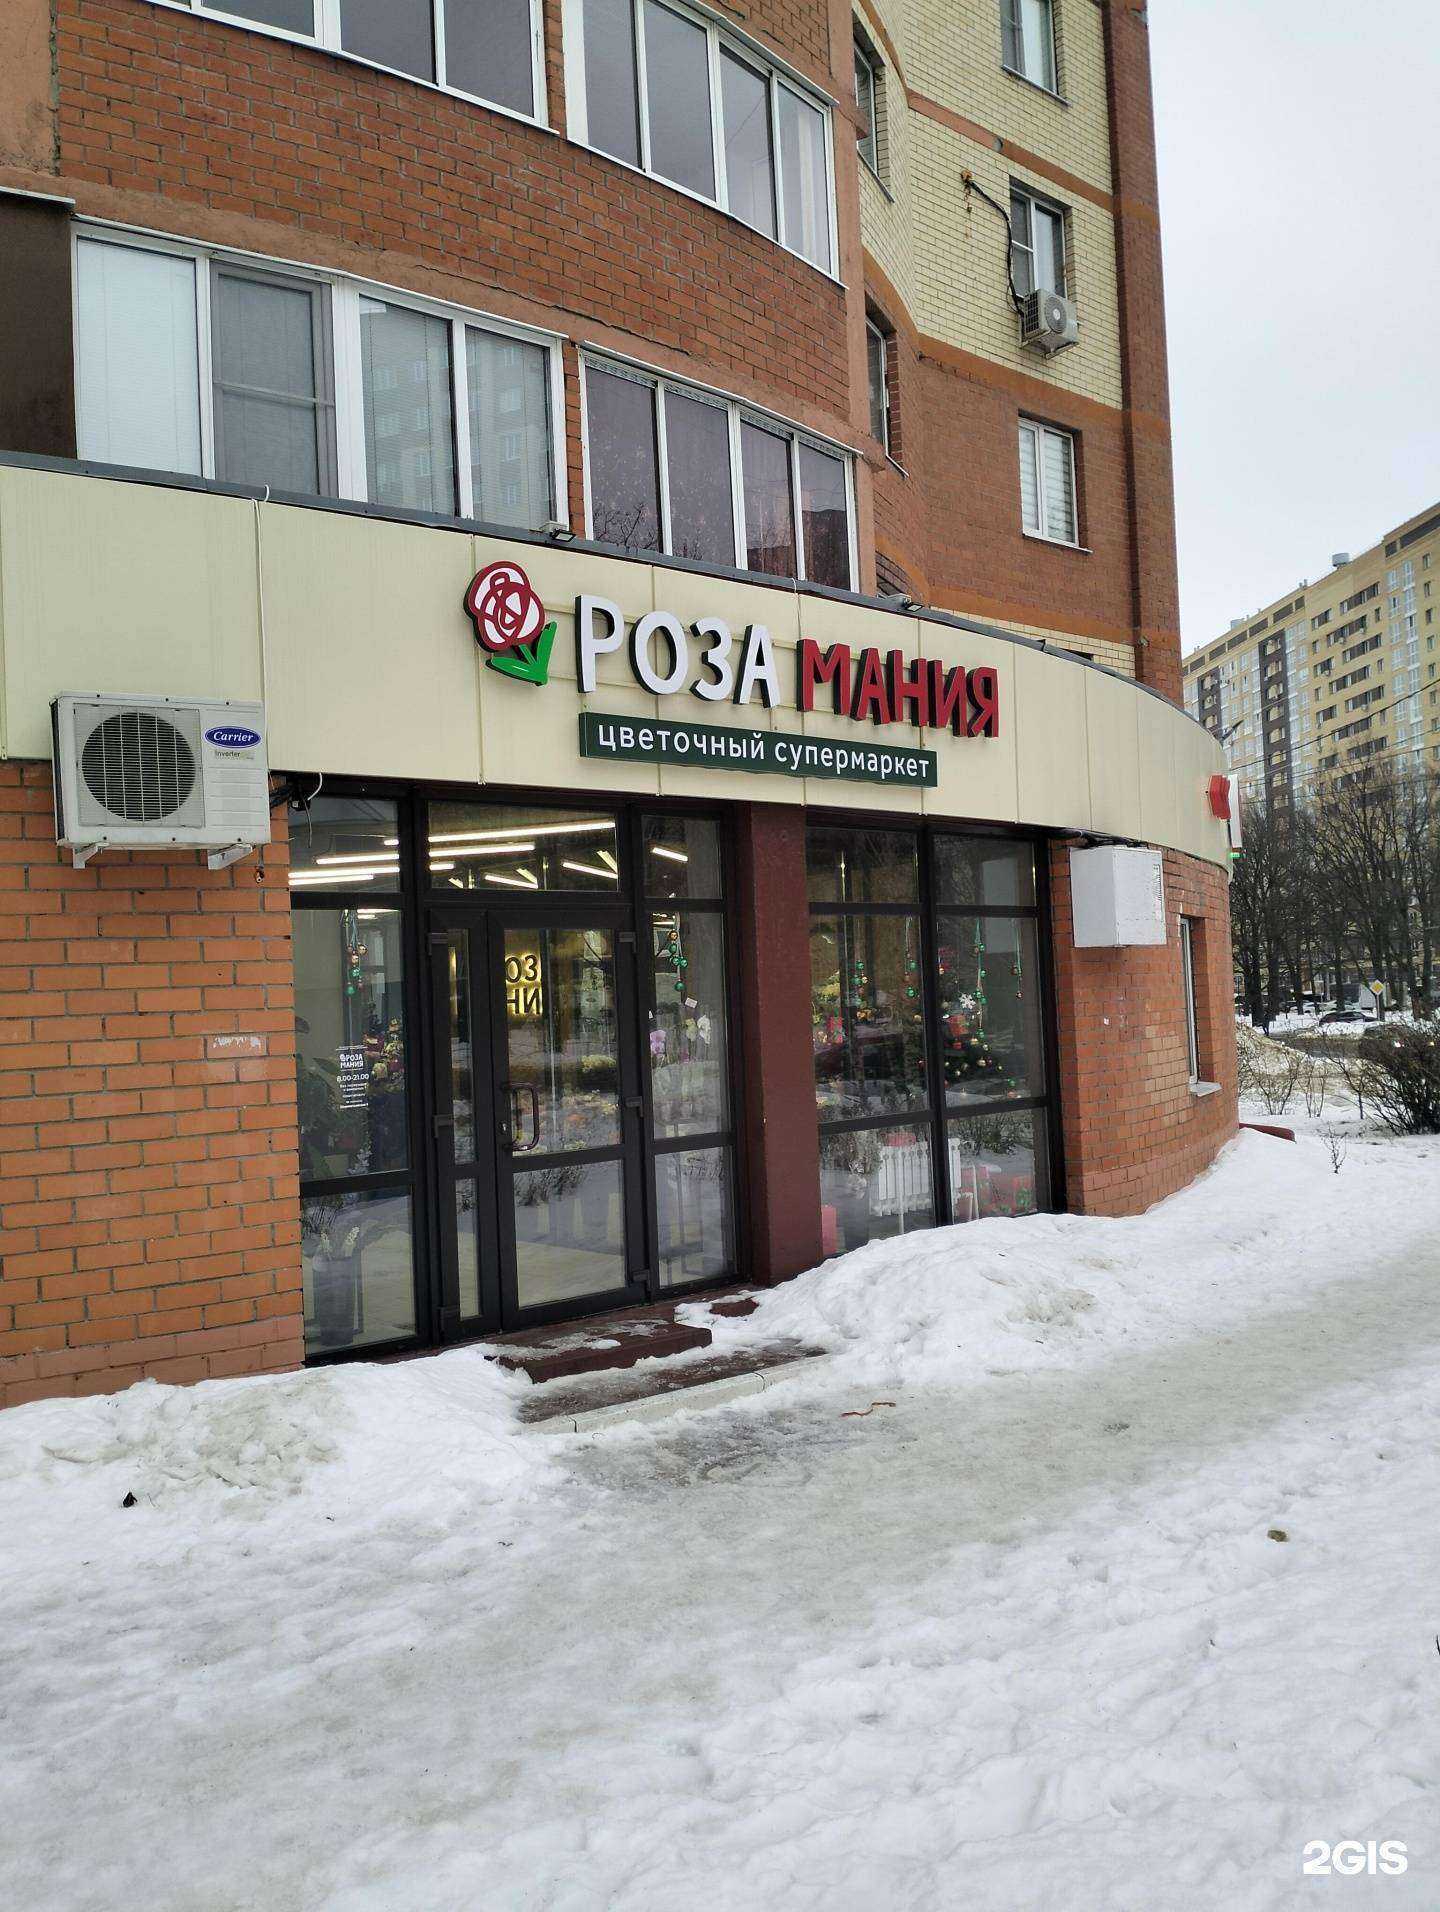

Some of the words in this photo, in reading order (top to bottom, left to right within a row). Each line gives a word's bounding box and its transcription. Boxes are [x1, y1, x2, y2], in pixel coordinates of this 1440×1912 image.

[575, 594, 780, 708] РОЗА
[797, 638, 999, 738] МАНИЯ
[213, 731, 253, 741] Carrier
[598, 723, 765, 760] цветочный
[774, 741, 930, 779] супермаркет
